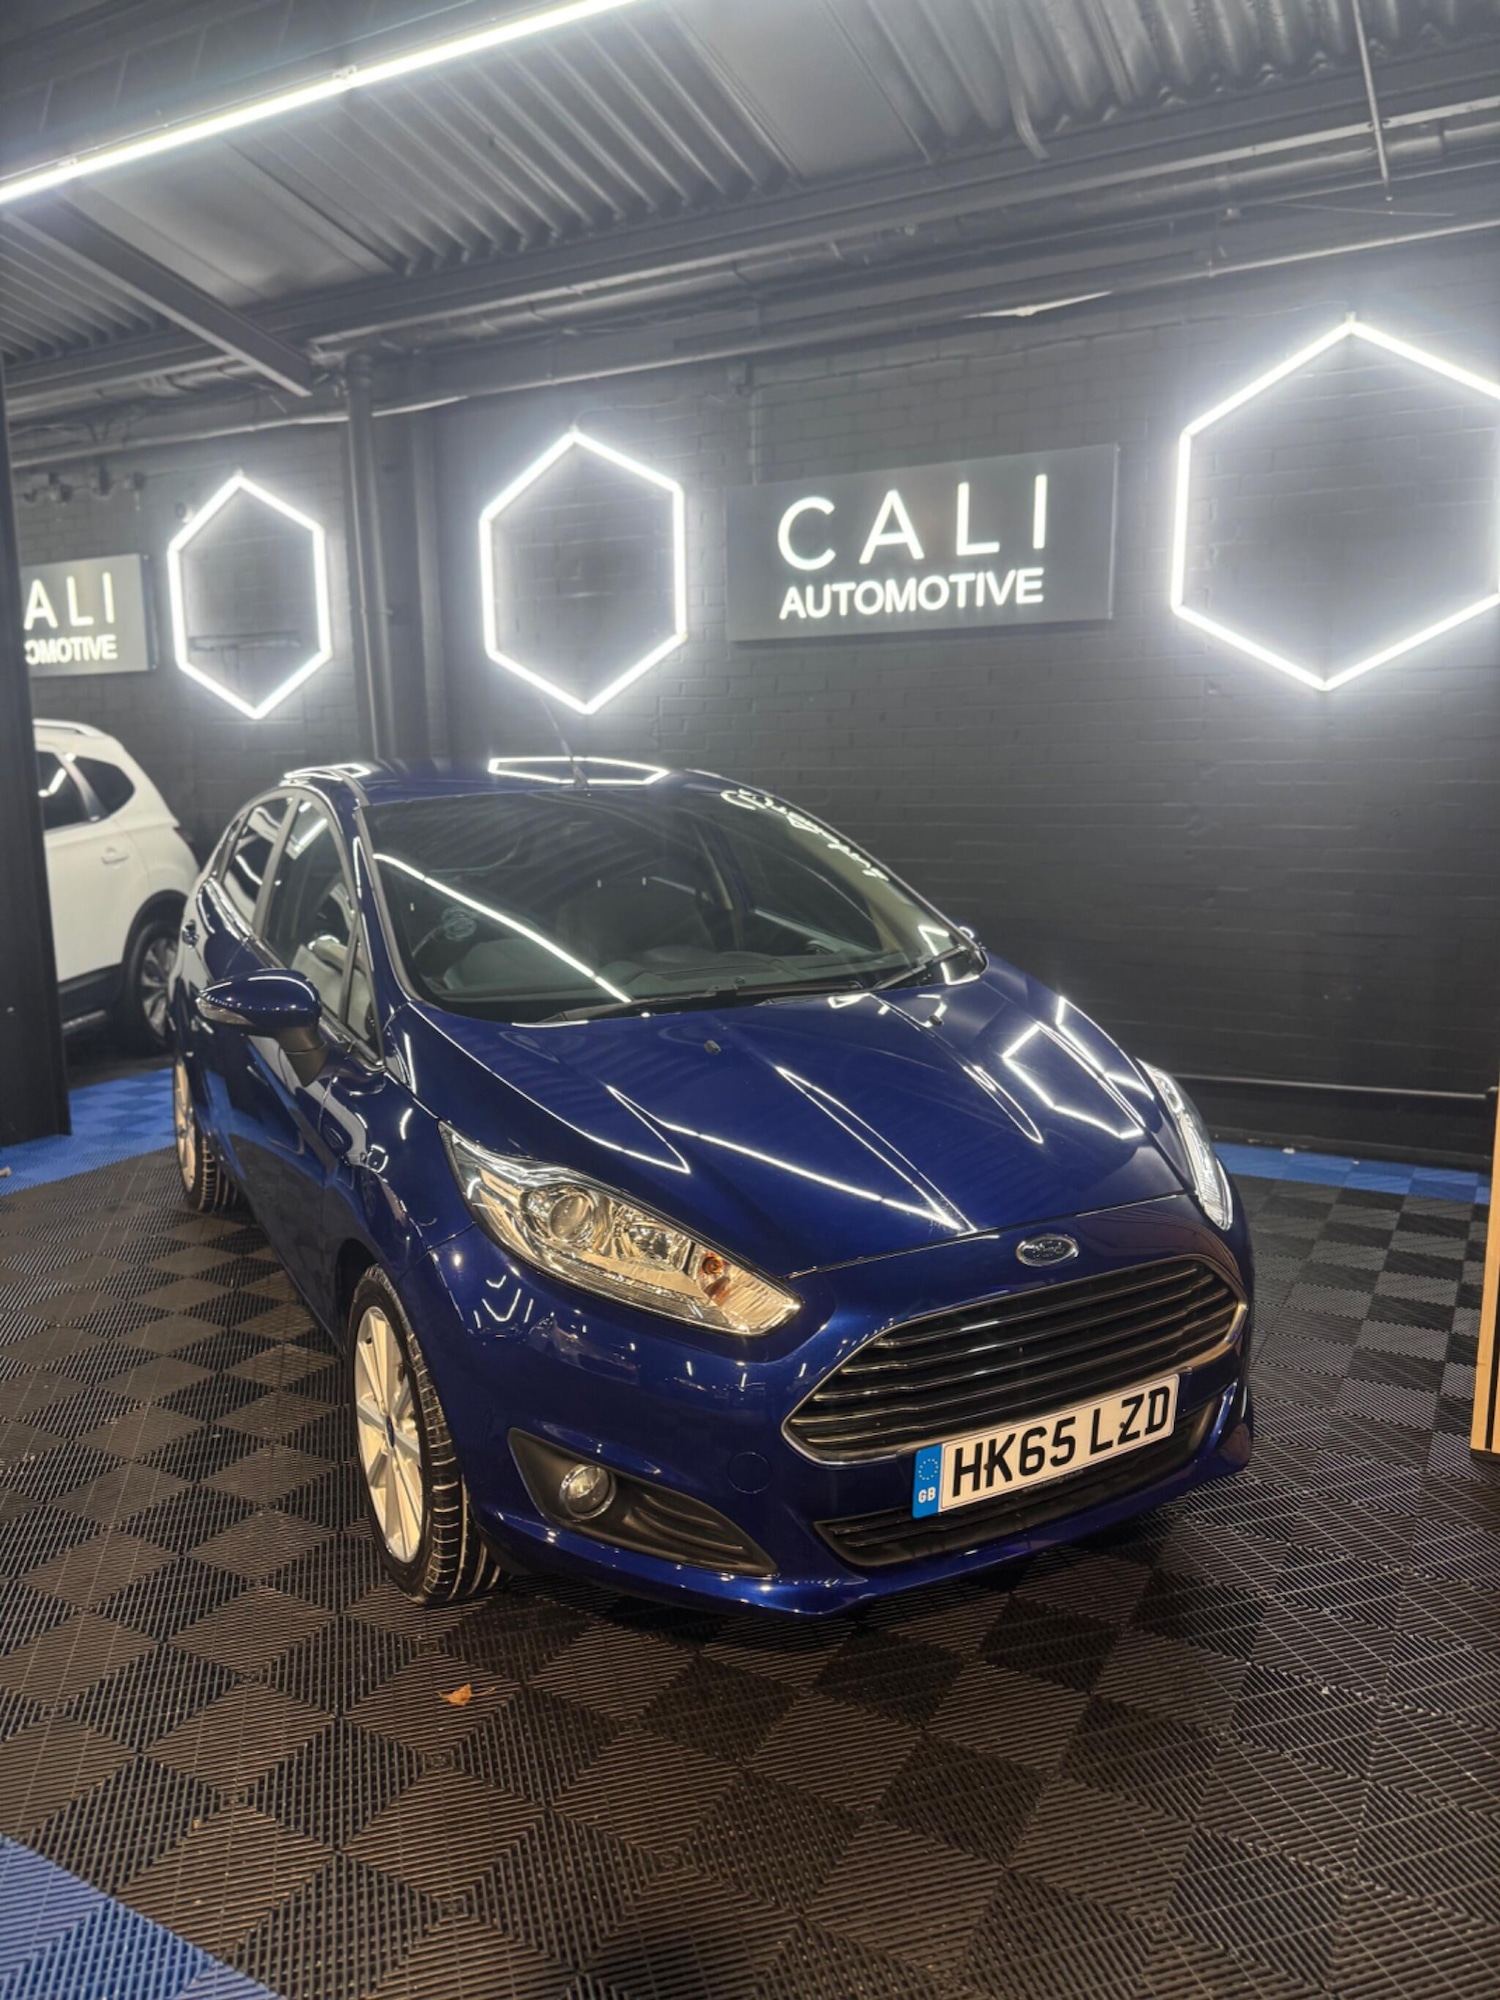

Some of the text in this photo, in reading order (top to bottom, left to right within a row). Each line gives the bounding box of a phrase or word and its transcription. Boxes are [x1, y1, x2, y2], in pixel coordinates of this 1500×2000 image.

[777, 474, 1048, 571] CALI
[23, 571, 115, 631] ALI
[778, 567, 1045, 620] AUTOMOTIVE
[24, 633, 118, 665] OMOTIVE
[951, 1385, 1170, 1498] HK65 LZD
[918, 1486, 936, 1504] GB
